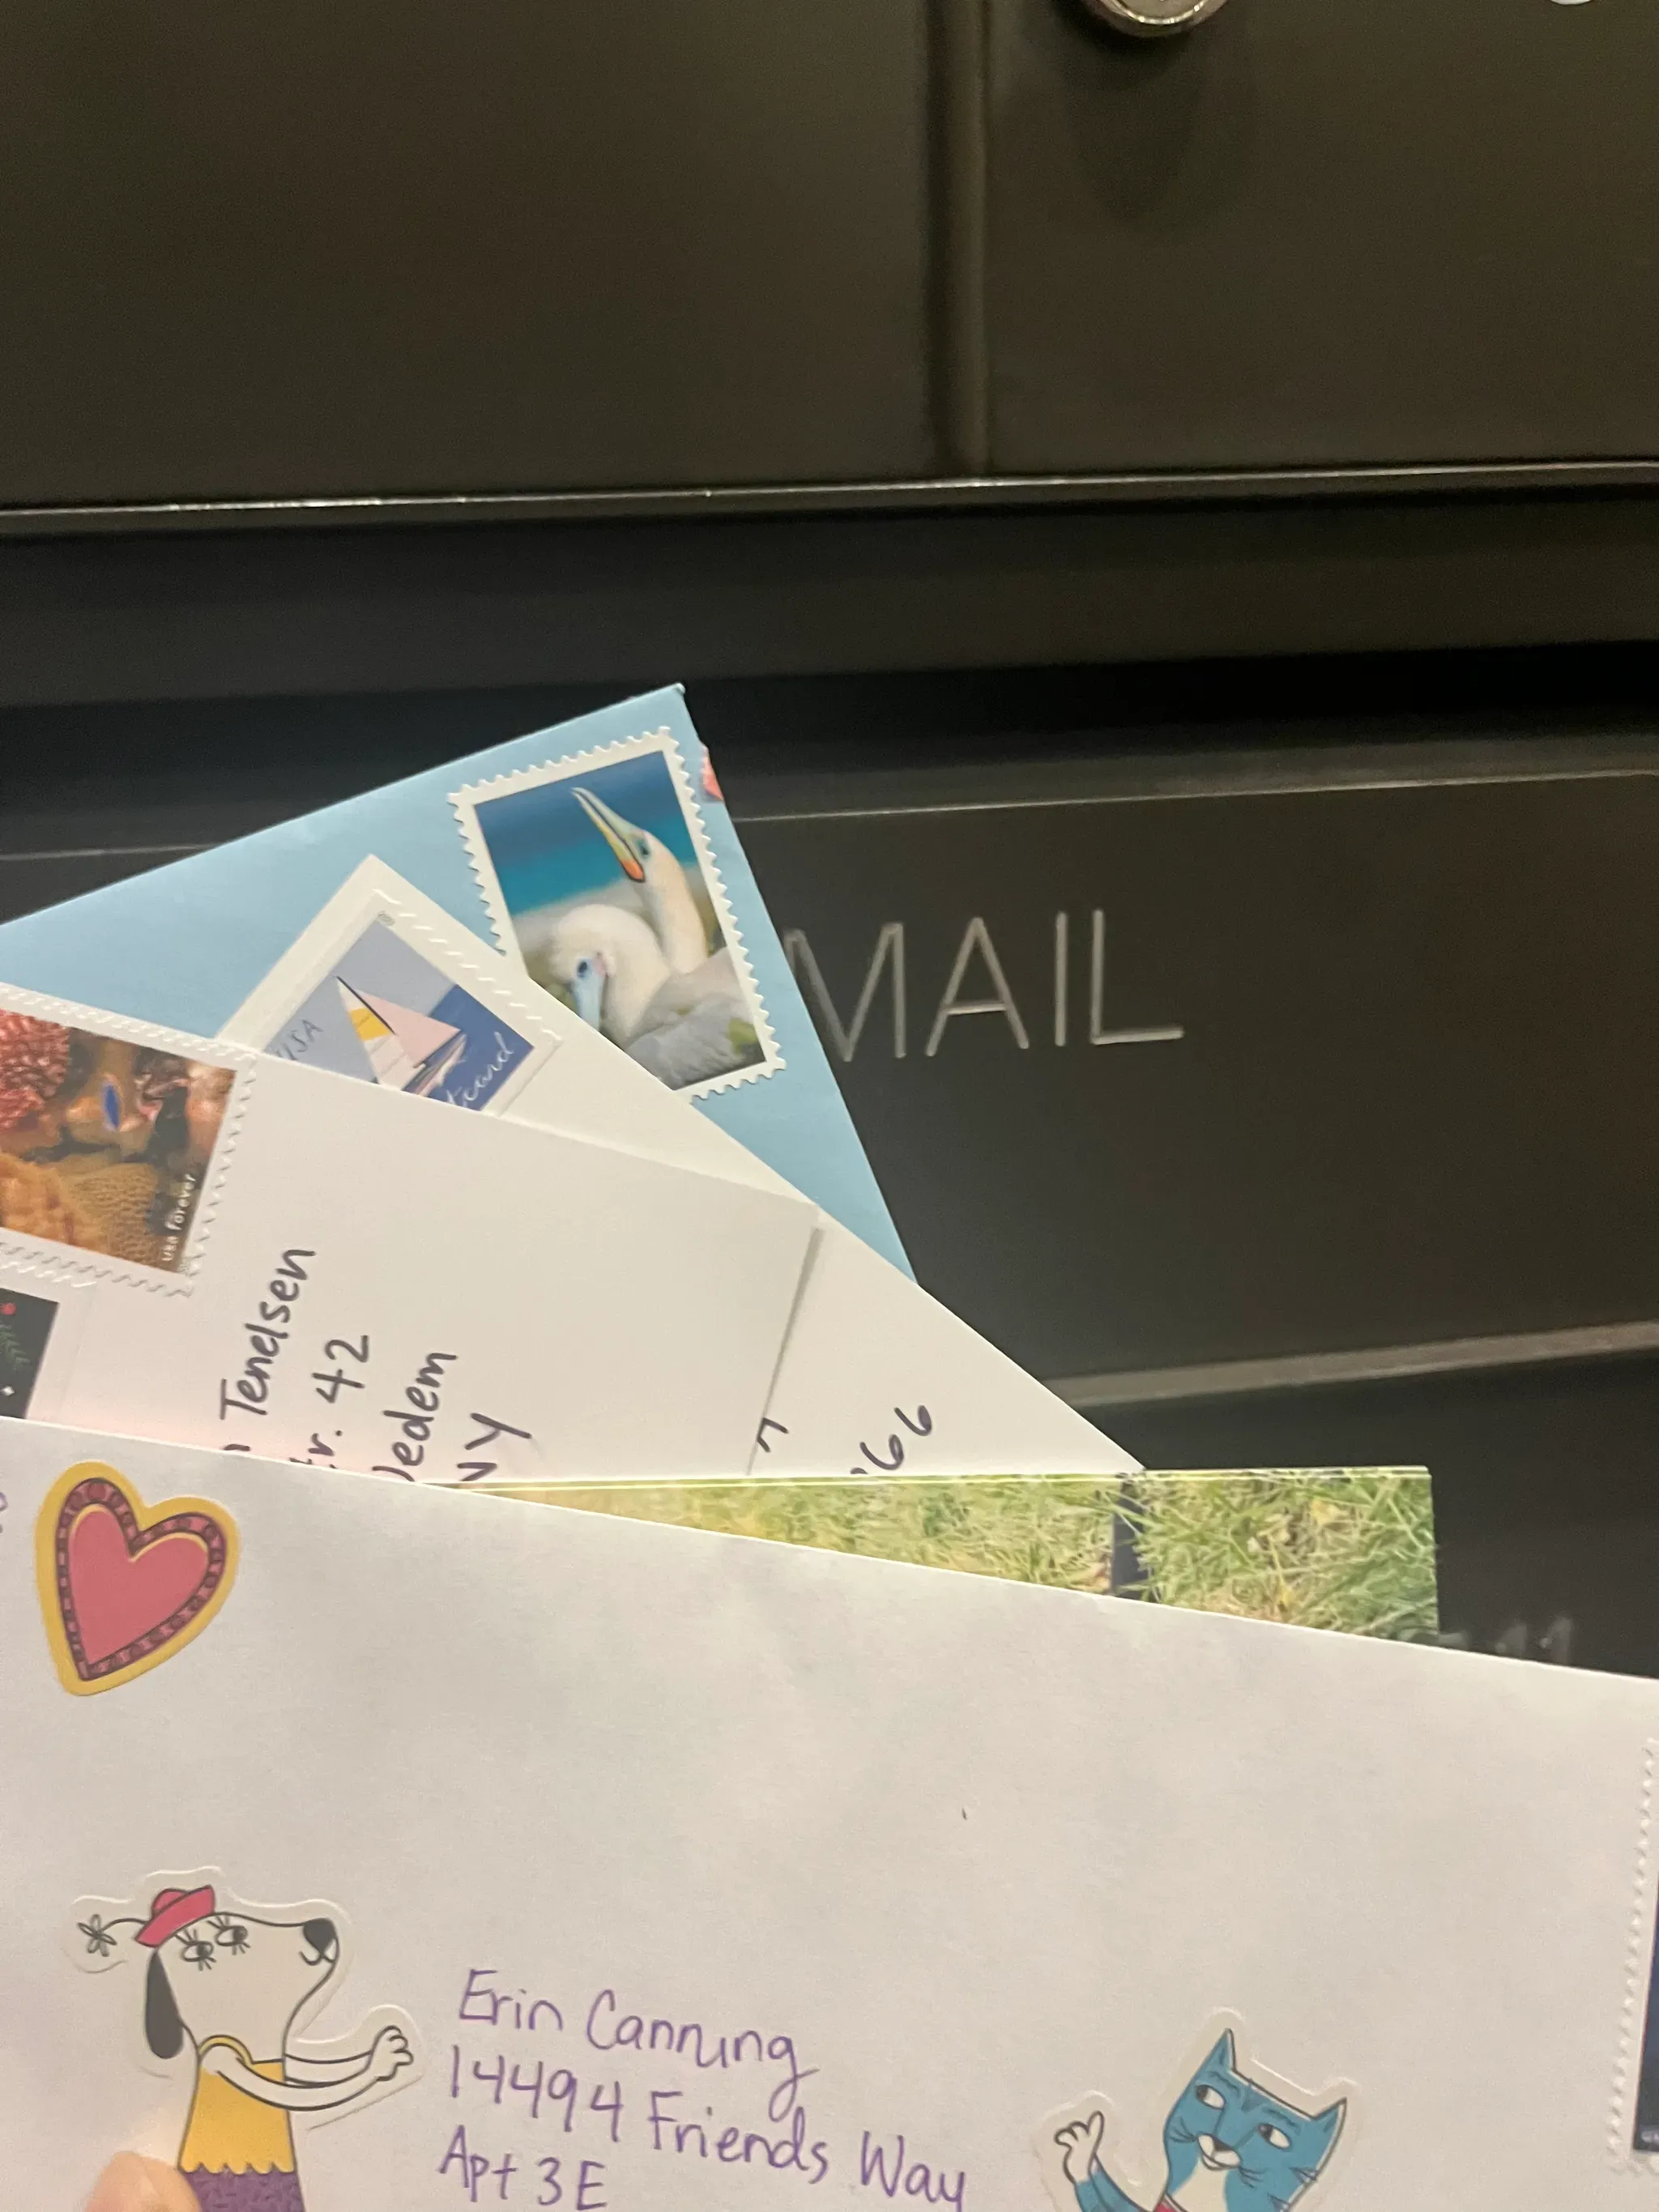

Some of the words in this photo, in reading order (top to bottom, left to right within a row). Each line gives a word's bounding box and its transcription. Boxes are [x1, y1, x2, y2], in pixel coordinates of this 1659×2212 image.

[783, 908, 1184, 1062] MAIL
[164, 1173, 196, 1231] forever
[310, 1334, 369, 1404] 42
[458, 1968, 563, 2031] Erin
[438, 2125, 518, 2204] Apt
[450, 2045, 625, 2143] 14494
[647, 2091, 829, 2184] Friends
[860, 2130, 966, 2212] Way
